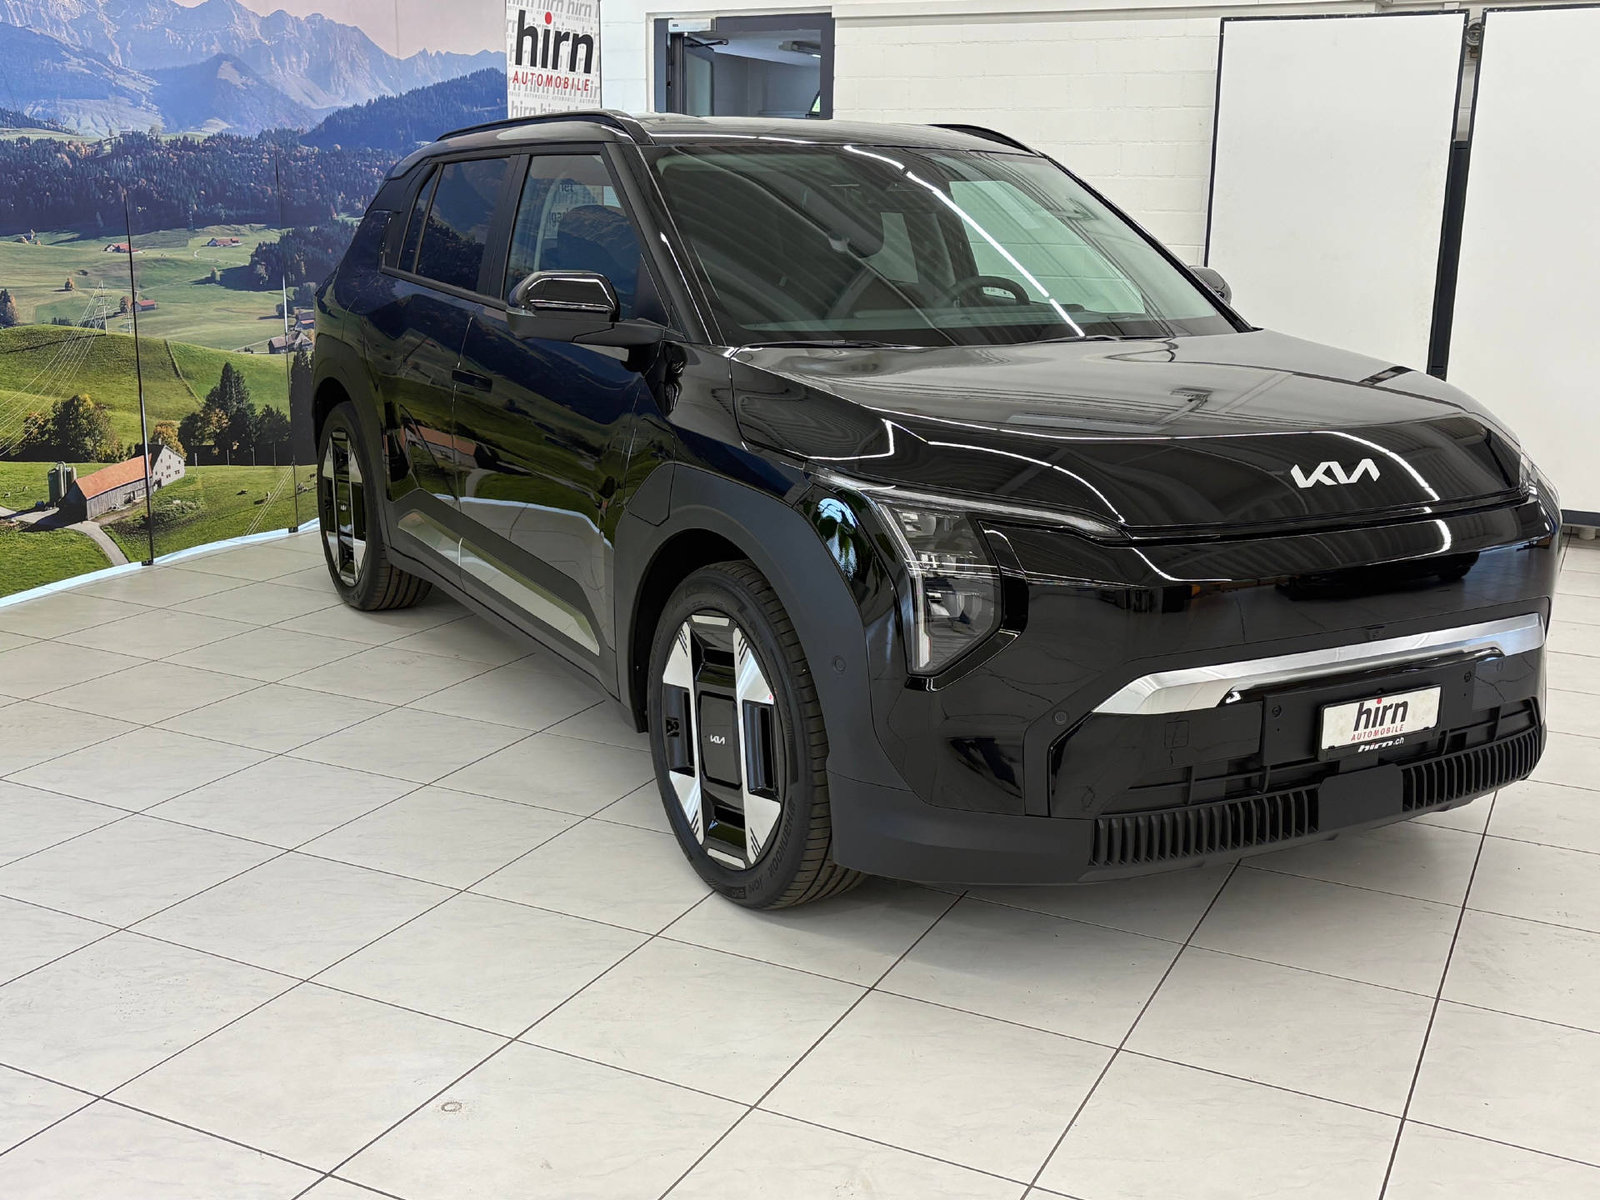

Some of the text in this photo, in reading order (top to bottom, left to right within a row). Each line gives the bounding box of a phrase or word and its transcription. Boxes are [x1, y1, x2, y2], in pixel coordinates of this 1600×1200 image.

[515, 9, 593, 74] hirn
[512, 71, 590, 91] AUTOMOBILE
[1290, 458, 1381, 489] KIA
[1353, 697, 1409, 732] hirn
[1350, 724, 1405, 742] AUTOMOBILE
